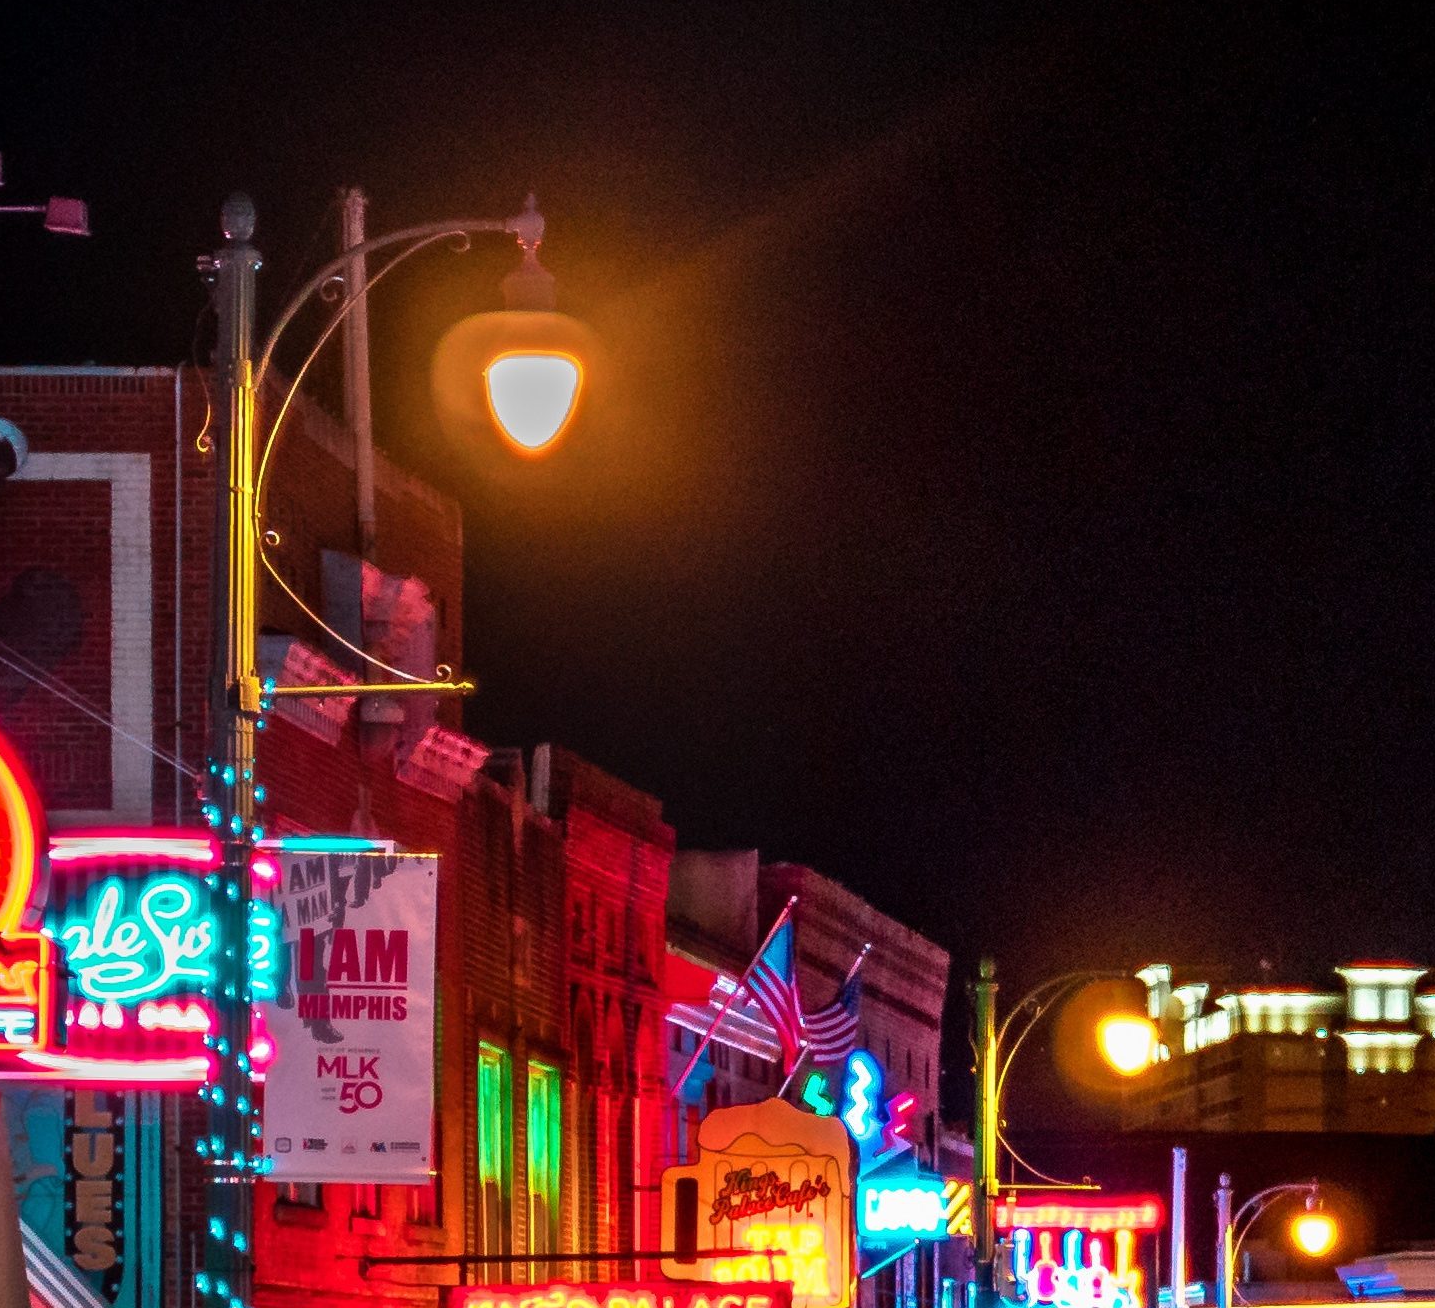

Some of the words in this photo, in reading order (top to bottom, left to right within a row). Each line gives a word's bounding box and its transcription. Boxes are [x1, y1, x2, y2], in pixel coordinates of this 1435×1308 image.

[289, 856, 325, 893] AM
[64, 880, 146, 960] ale
[299, 928, 315, 982] I
[328, 928, 409, 983] AM
[298, 994, 408, 1021] MEMPHIS
[317, 1054, 380, 1080] MLK
[338, 1080, 383, 1115] 50
[72, 1089, 117, 1271] LUES
[743, 1223, 825, 1252] TAP
